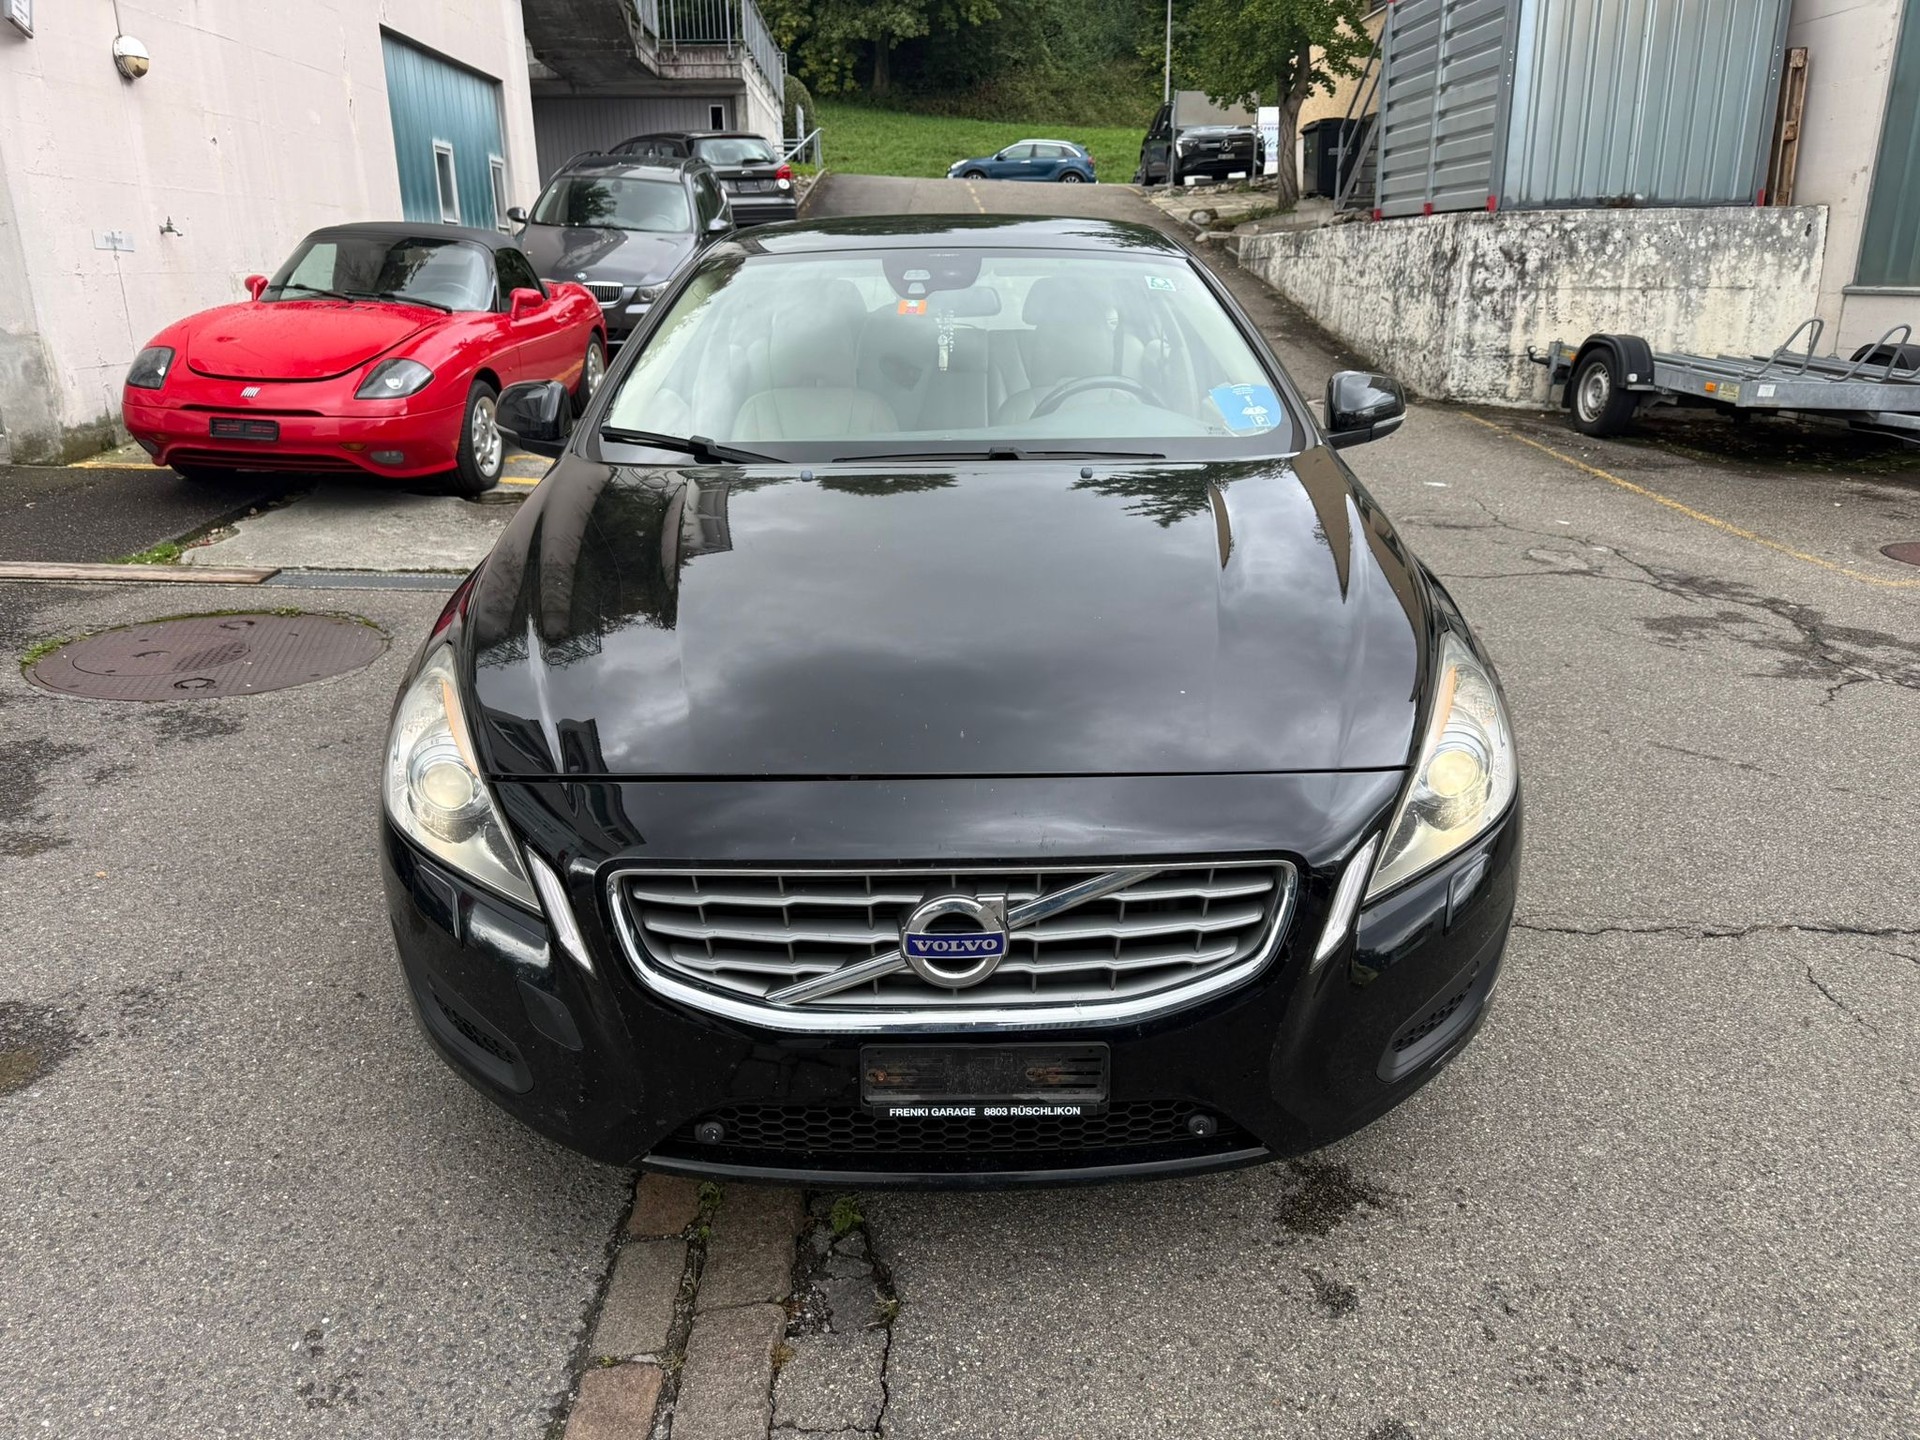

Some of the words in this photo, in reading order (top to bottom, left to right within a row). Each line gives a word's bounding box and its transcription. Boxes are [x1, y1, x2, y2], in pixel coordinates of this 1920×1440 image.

[912, 939, 998, 951] VOLVO
[889, 1107, 929, 1117] FRENKI
[930, 1107, 976, 1117] GARAGE
[983, 1107, 1008, 1116] 8803
[1010, 1105, 1081, 1116] RÜSCHLIKON
